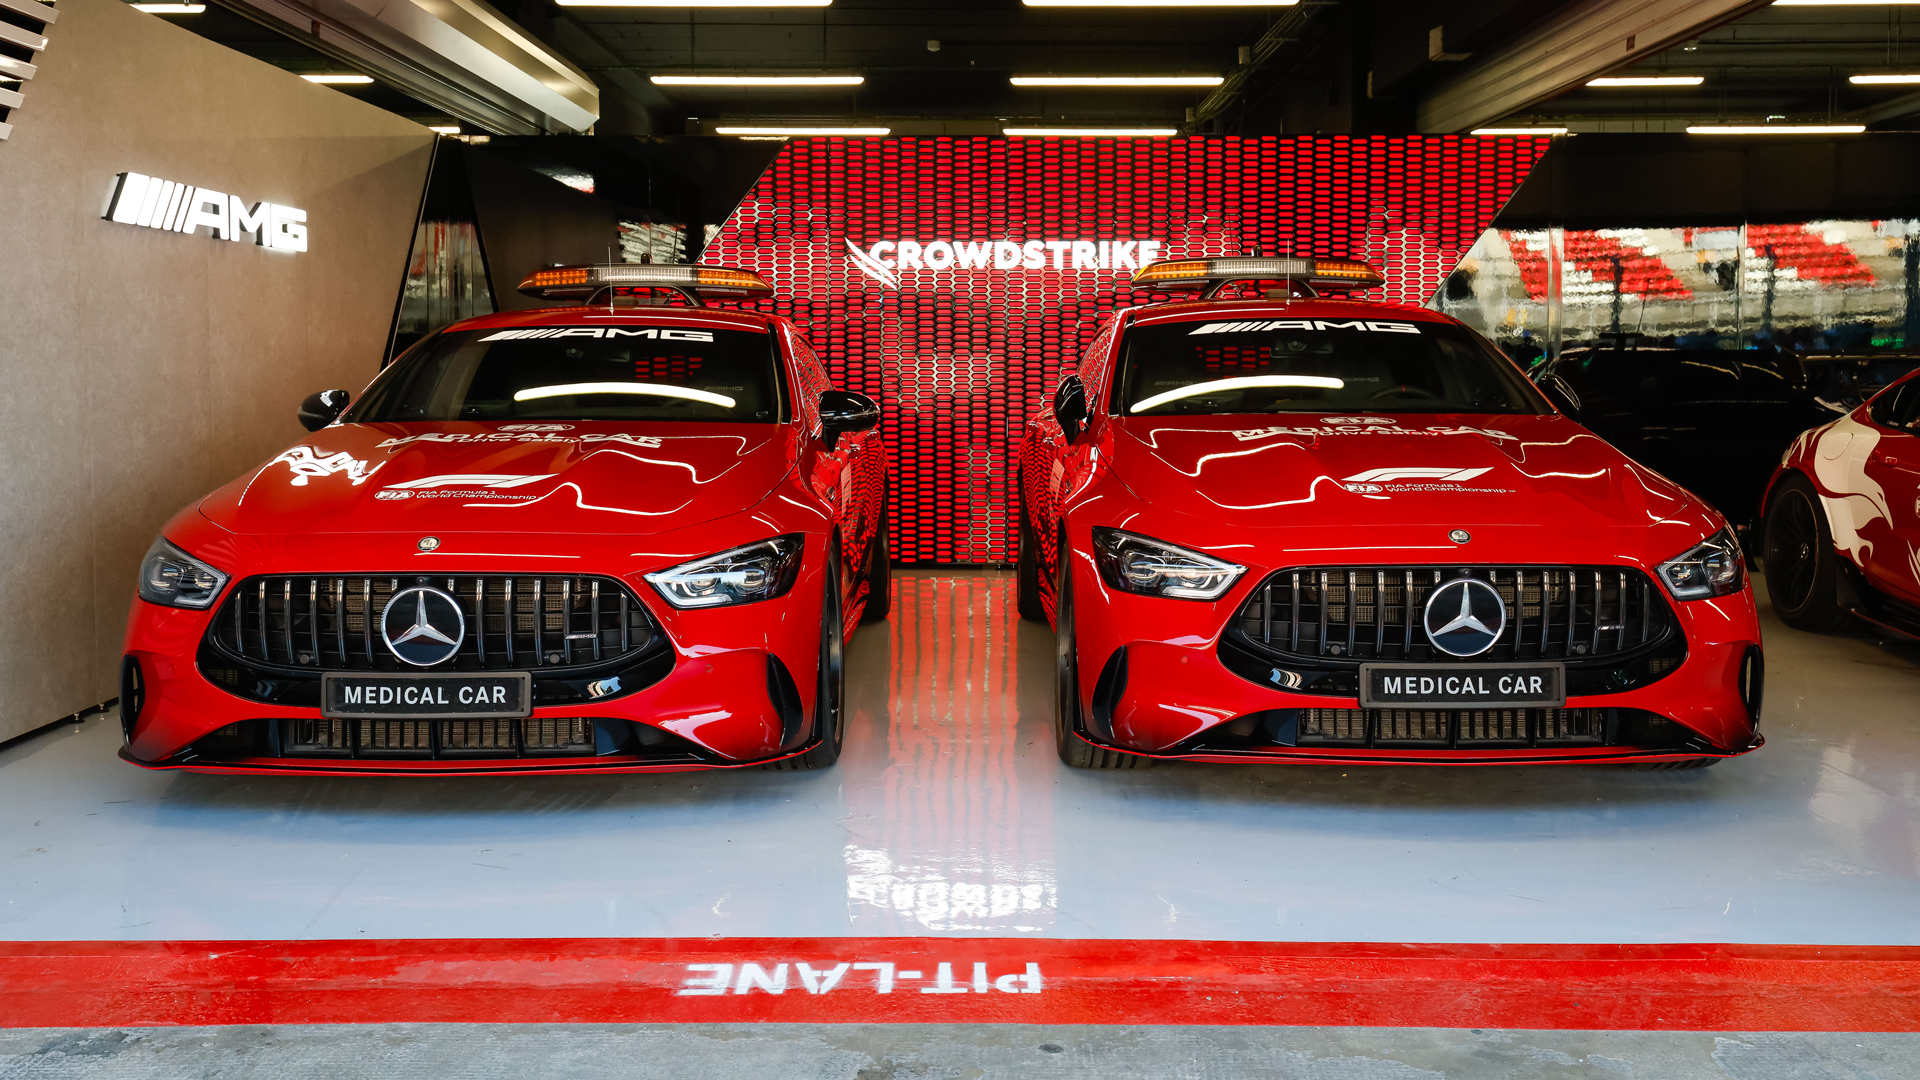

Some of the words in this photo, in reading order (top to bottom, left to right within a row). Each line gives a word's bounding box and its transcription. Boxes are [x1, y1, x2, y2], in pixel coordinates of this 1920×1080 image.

[182, 187, 308, 252] AMG
[869, 240, 1161, 269] CROWDSTRIKE
[553, 328, 714, 342] AMG
[1262, 320, 1421, 334] AMG
[1383, 676, 1490, 695] MEDICAL
[1498, 676, 1543, 695] CAR
[344, 686, 449, 705] MEDICAL
[458, 686, 507, 704] CAR
[678, 962, 1043, 996] PIT-LANE
